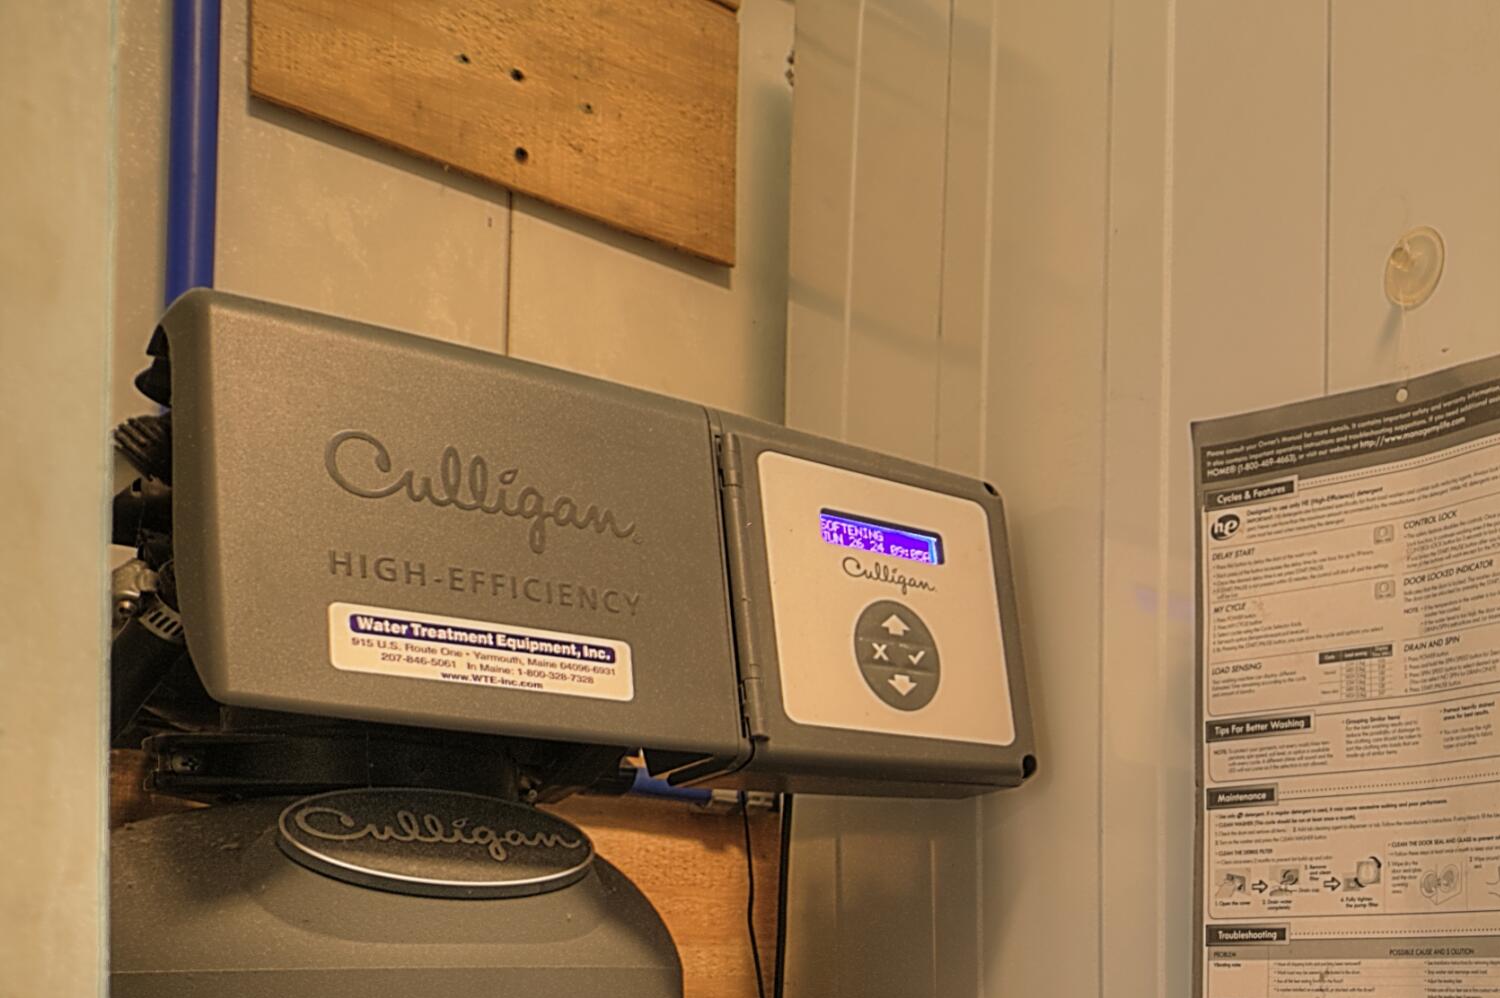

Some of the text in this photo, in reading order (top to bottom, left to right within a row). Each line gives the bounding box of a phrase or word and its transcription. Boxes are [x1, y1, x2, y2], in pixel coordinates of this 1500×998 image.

[324, 430, 637, 554] Culligan
[1216, 489, 1242, 506] Cycles
[1243, 488, 1251, 500] &
[1252, 482, 1286, 499] Features
[821, 518, 885, 542] SOFTENING
[1403, 508, 1457, 531] CONTROL LOCK
[1211, 546, 1255, 562] DELAY START
[328, 550, 640, 616] HIGH-EFFICIENCY
[842, 556, 936, 595] Culligan
[1403, 573, 1426, 587] DOOR
[1427, 567, 1454, 582] LOCKED
[1455, 558, 1493, 575] INDICATOR
[1213, 601, 1246, 614] MY CYCLE
[356, 615, 611, 660] Water Treatment Equipment, Inc.
[1403, 634, 1460, 653] DRAIN AND SPIN
[376, 639, 401, 650] U.S.
[405, 642, 438, 655] Route
[439, 647, 463, 657] One
[473, 651, 524, 665] Yarmouth,
[527, 657, 557, 669] Maine
[466, 661, 476, 671] In
[479, 663, 515, 675] Maine:
[1211, 661, 1262, 676] LOAD SENSING
[1214, 717, 1304, 737] Tips For Better Washing
[1217, 790, 1266, 803] Maintenance
[295, 807, 581, 862] Culligan
[1217, 929, 1277, 940] Troubleshooting
